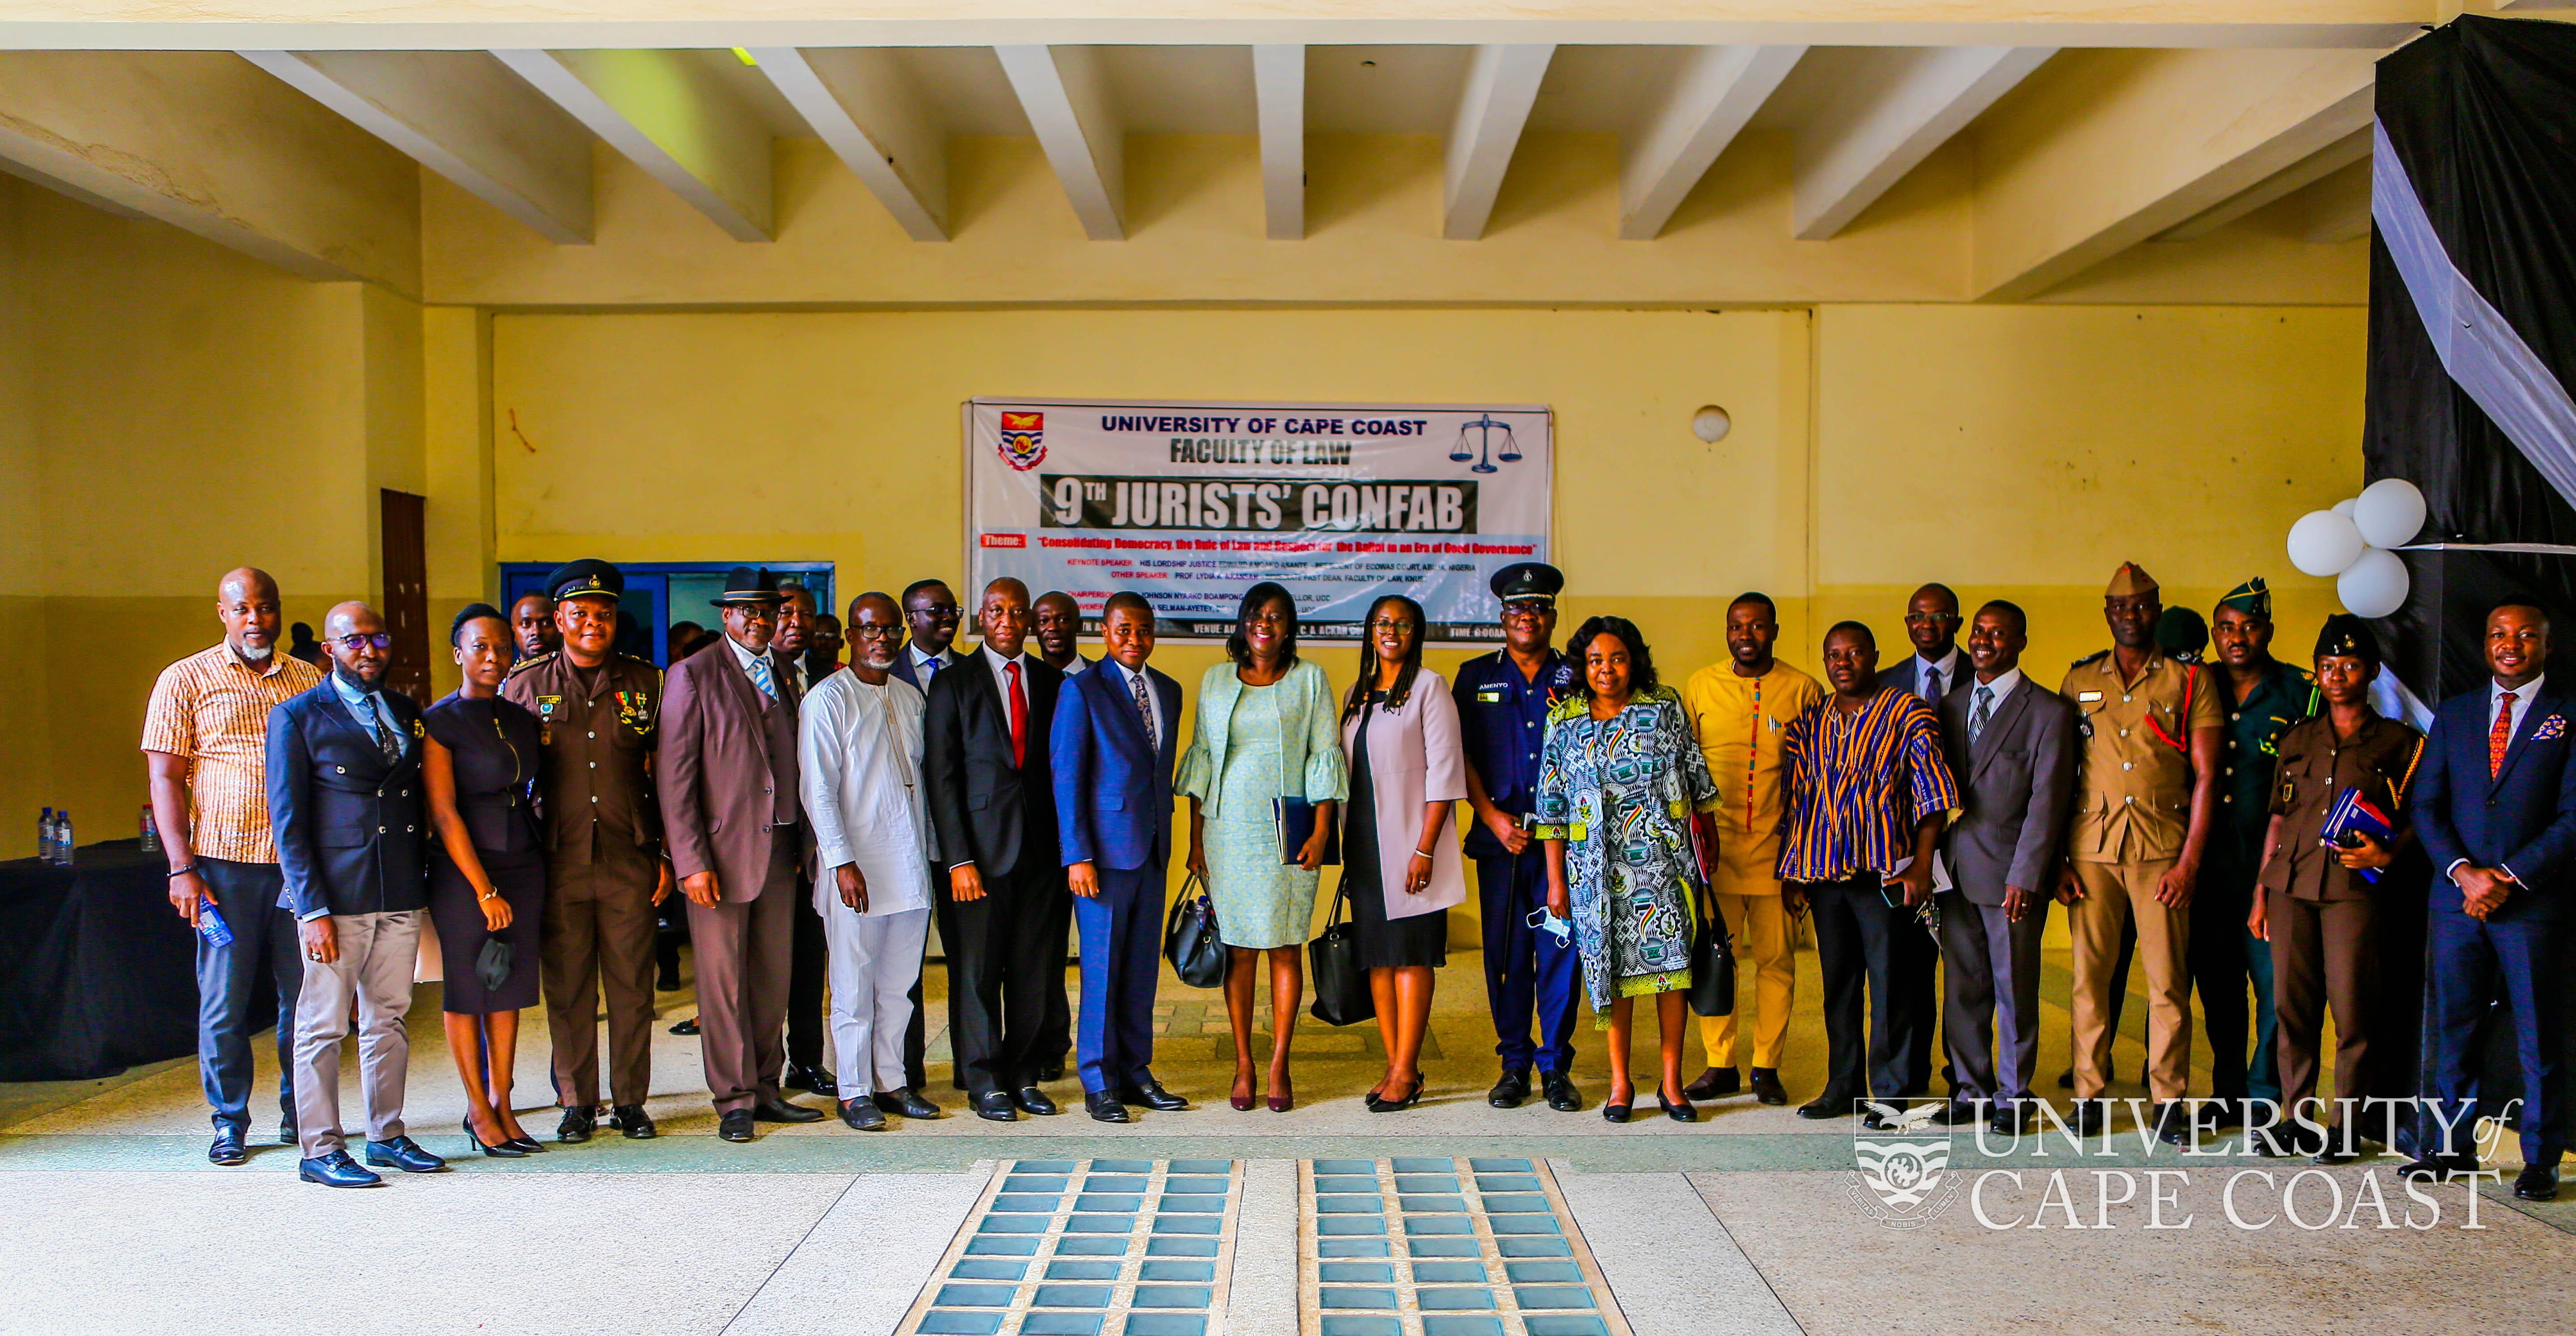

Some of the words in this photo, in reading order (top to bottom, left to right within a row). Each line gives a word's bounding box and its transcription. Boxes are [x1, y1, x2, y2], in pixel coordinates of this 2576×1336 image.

[1102, 416, 1240, 433] UNIVERSITY
[1248, 418, 1277, 434] OF
[1284, 418, 1344, 434] CAPE
[1352, 420, 1427, 436] COAST
[1170, 438, 1265, 463] FACULTY
[1270, 439, 1293, 464] OF
[1302, 441, 1352, 465] LAW
[1054, 478, 1106, 526] 9TH
[1302, 485, 1463, 531] CONFAB
[985, 536, 1022, 546] Theme:
[1114, 538, 1174, 550] Democracy,
[1176, 539, 1192, 550] the
[1195, 539, 1217, 550] Rule
[1220, 539, 1230, 550] of
[1232, 540, 1250, 550] Law
[1254, 540, 1272, 551] and
[1275, 540, 1315, 552] Respect
[1337, 542, 1353, 552] the
[1356, 542, 1385, 552] Ballot
[1388, 543, 1397, 552] in
[1399, 543, 1412, 553] an
[1415, 542, 1430, 553] Era
[1432, 543, 1442, 553] of
[1444, 543, 1470, 554] Good
